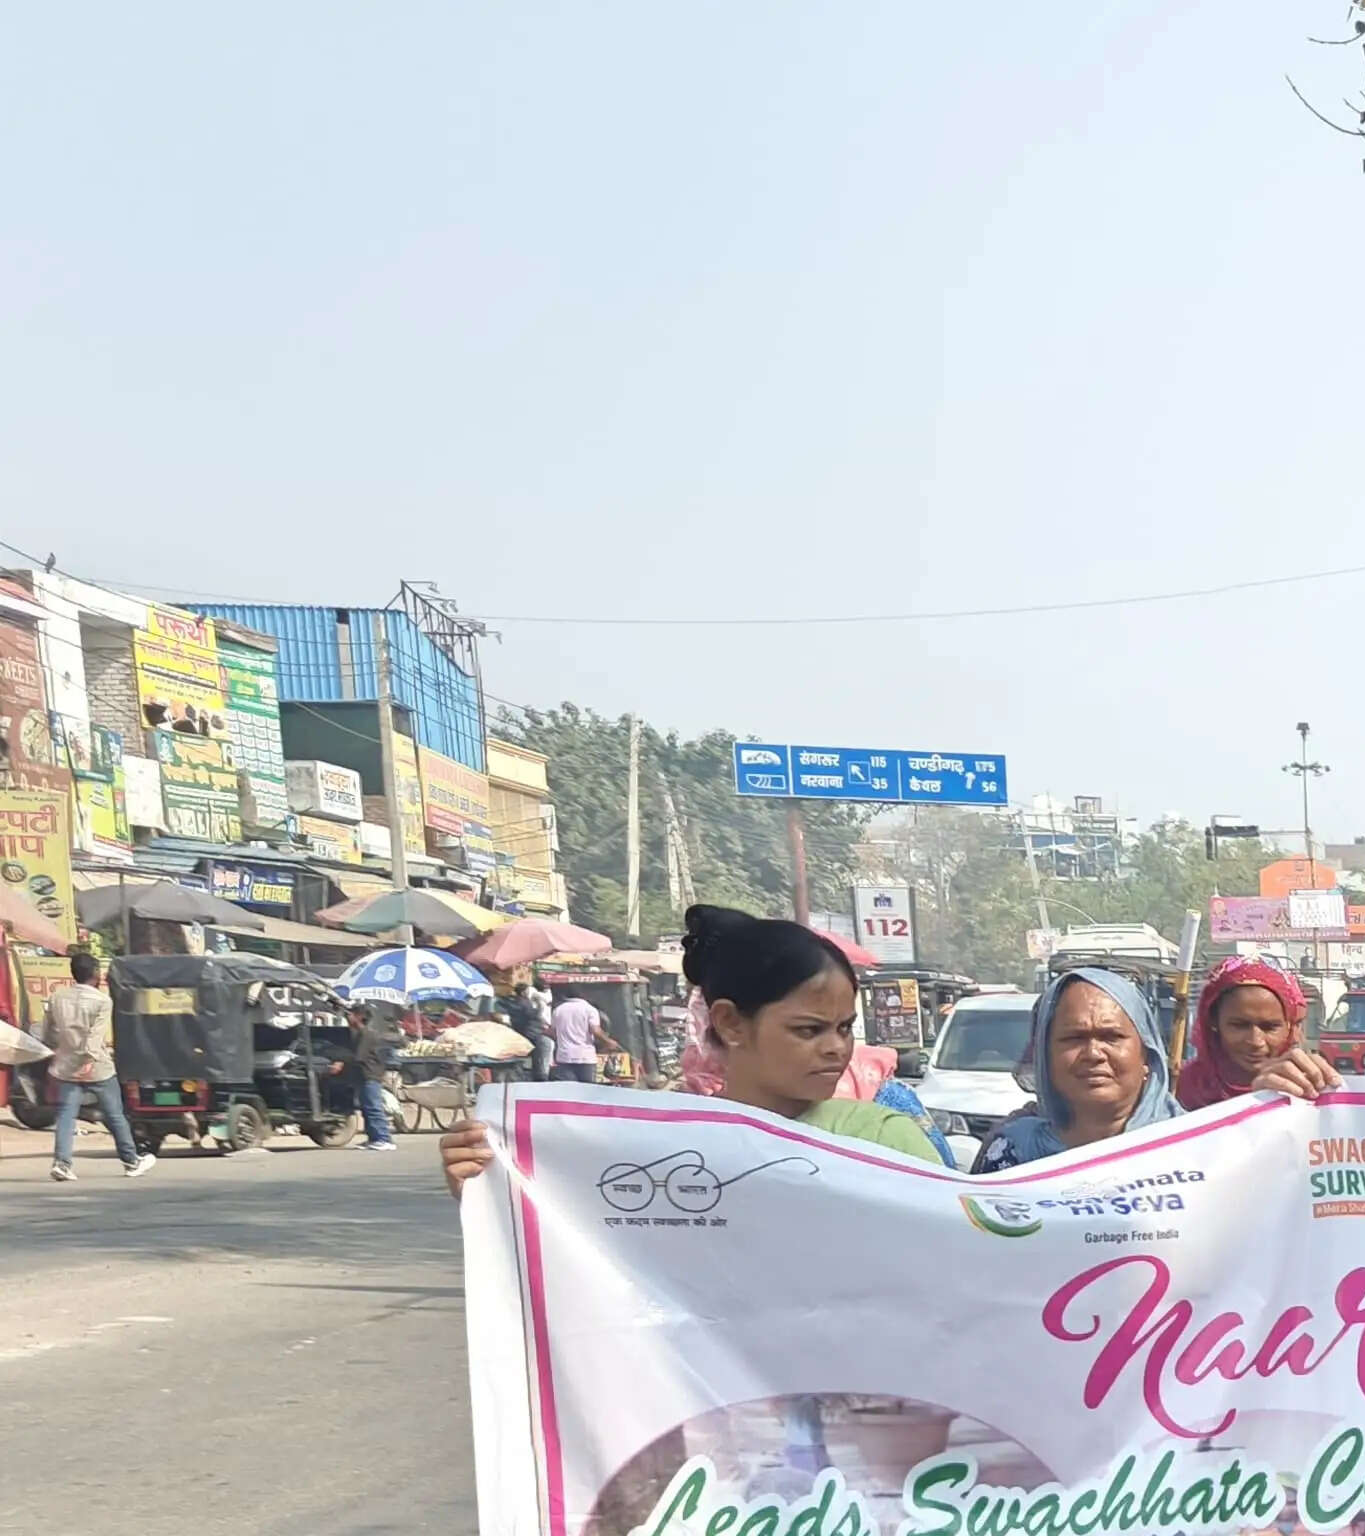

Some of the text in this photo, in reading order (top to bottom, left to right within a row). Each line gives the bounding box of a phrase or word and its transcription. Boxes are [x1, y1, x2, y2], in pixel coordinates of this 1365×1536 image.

[871, 778, 888, 790] 35
[982, 781, 997, 793] 56
[863, 918, 909, 937] 112
[1084, 1229, 1179, 1244] Garbage Free India
